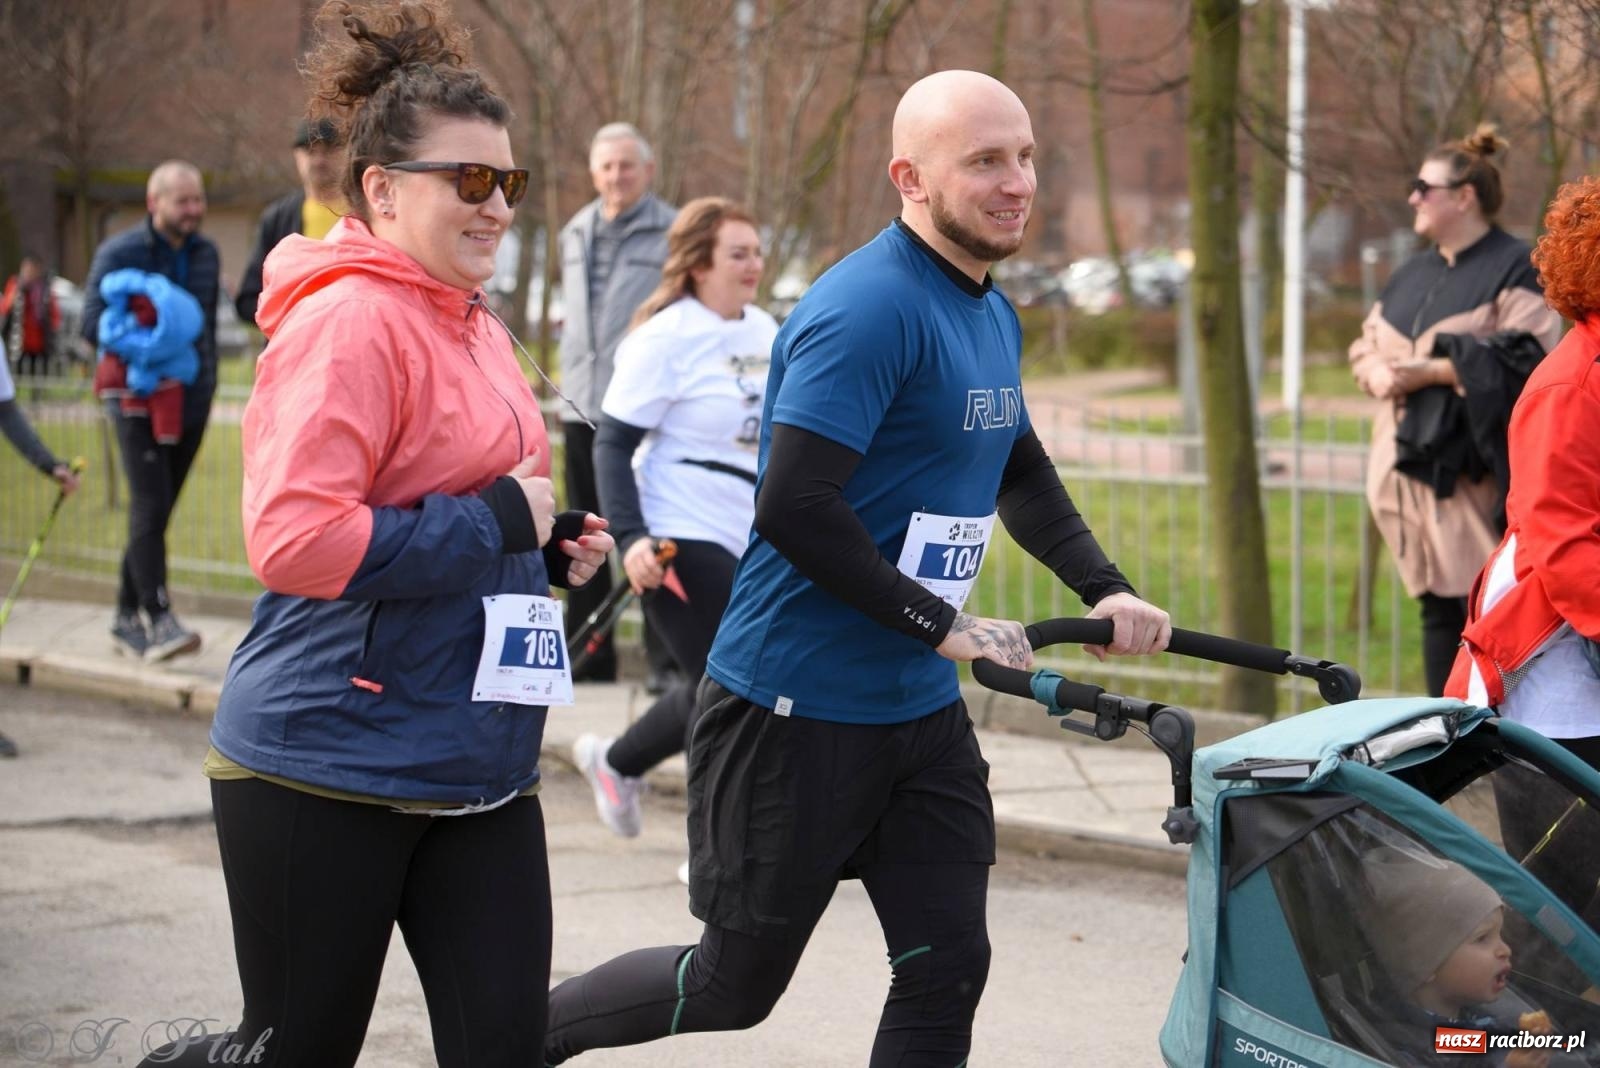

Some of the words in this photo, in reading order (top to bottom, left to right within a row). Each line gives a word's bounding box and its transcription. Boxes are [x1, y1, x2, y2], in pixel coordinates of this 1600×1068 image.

[964, 386, 1020, 430] RUN
[942, 546, 980, 578] 104
[524, 630, 558, 666] 103
